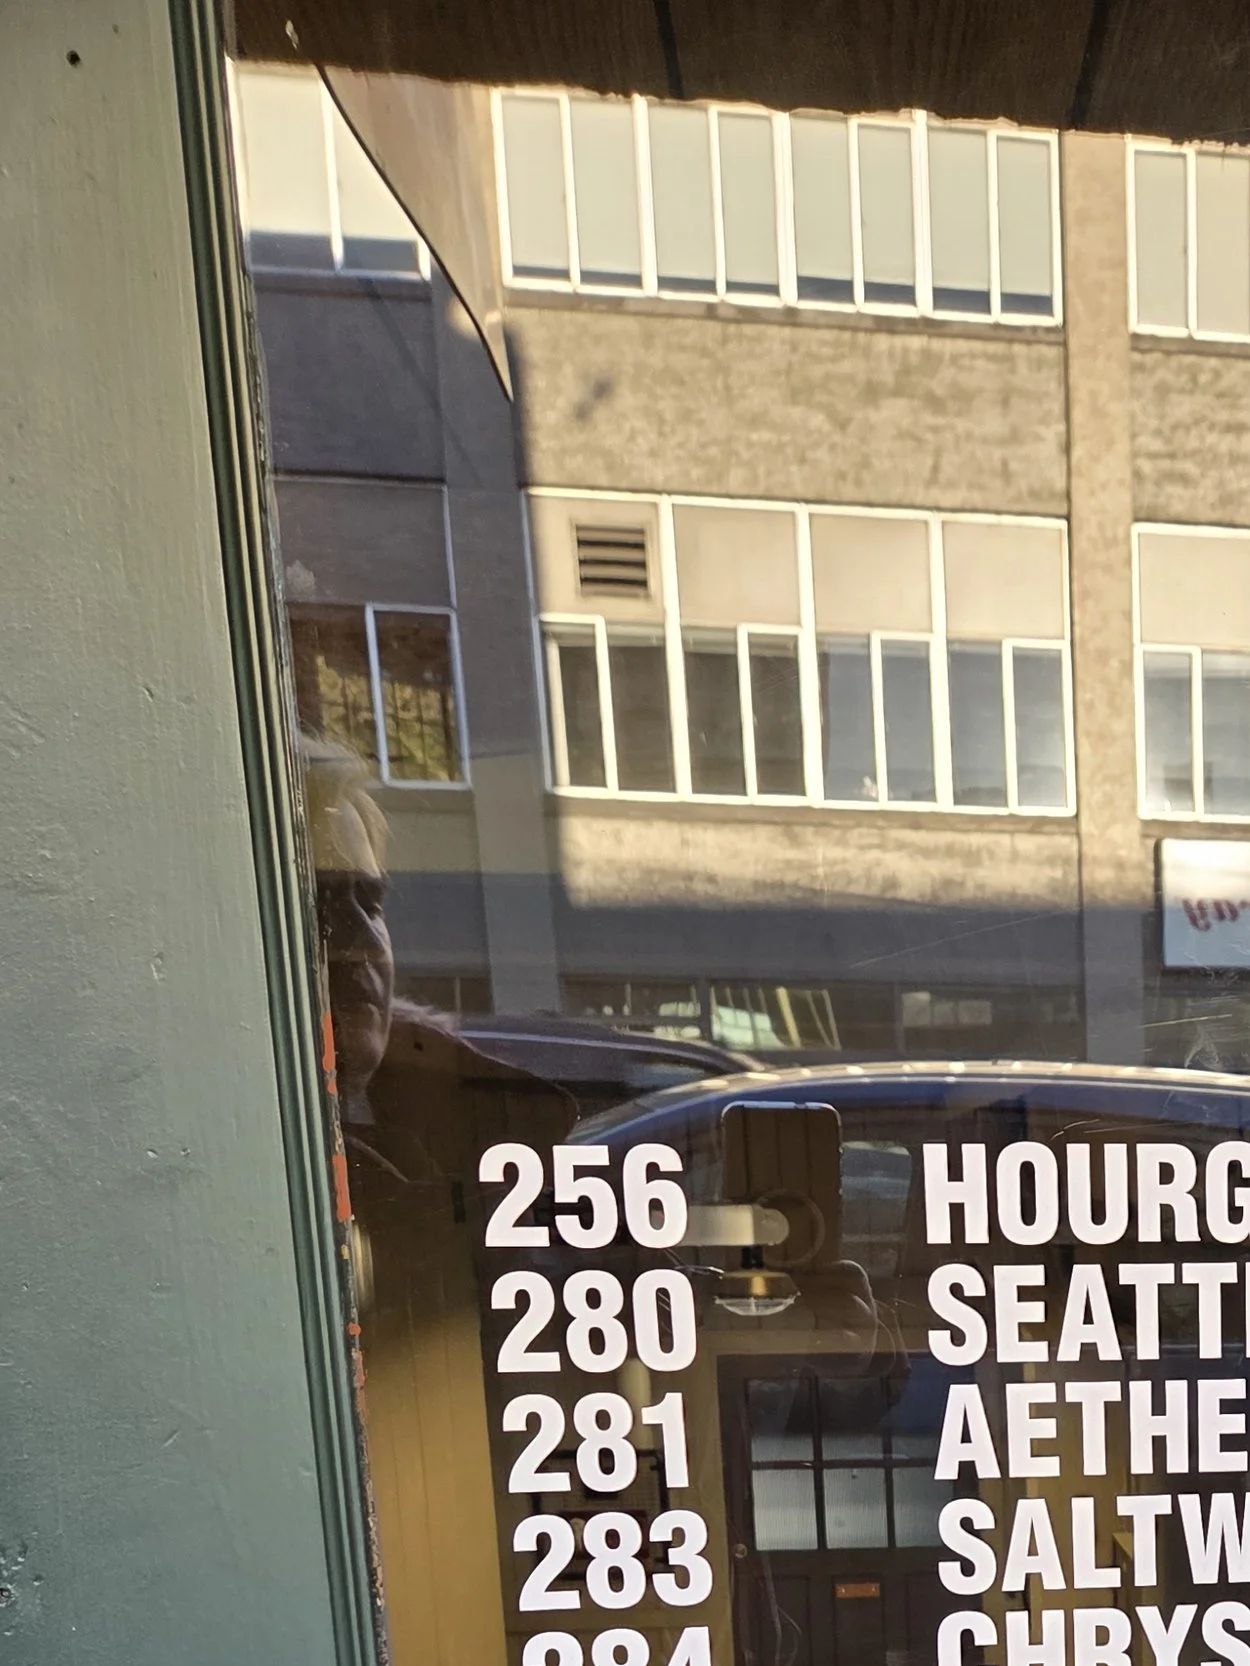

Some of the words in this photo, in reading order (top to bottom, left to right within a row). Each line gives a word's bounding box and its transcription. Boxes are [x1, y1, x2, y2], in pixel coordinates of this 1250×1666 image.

[479, 1143, 688, 1249] 256
[491, 1269, 697, 1373] 280
[502, 1392, 689, 1493] 281
[513, 1509, 713, 1612] 283
